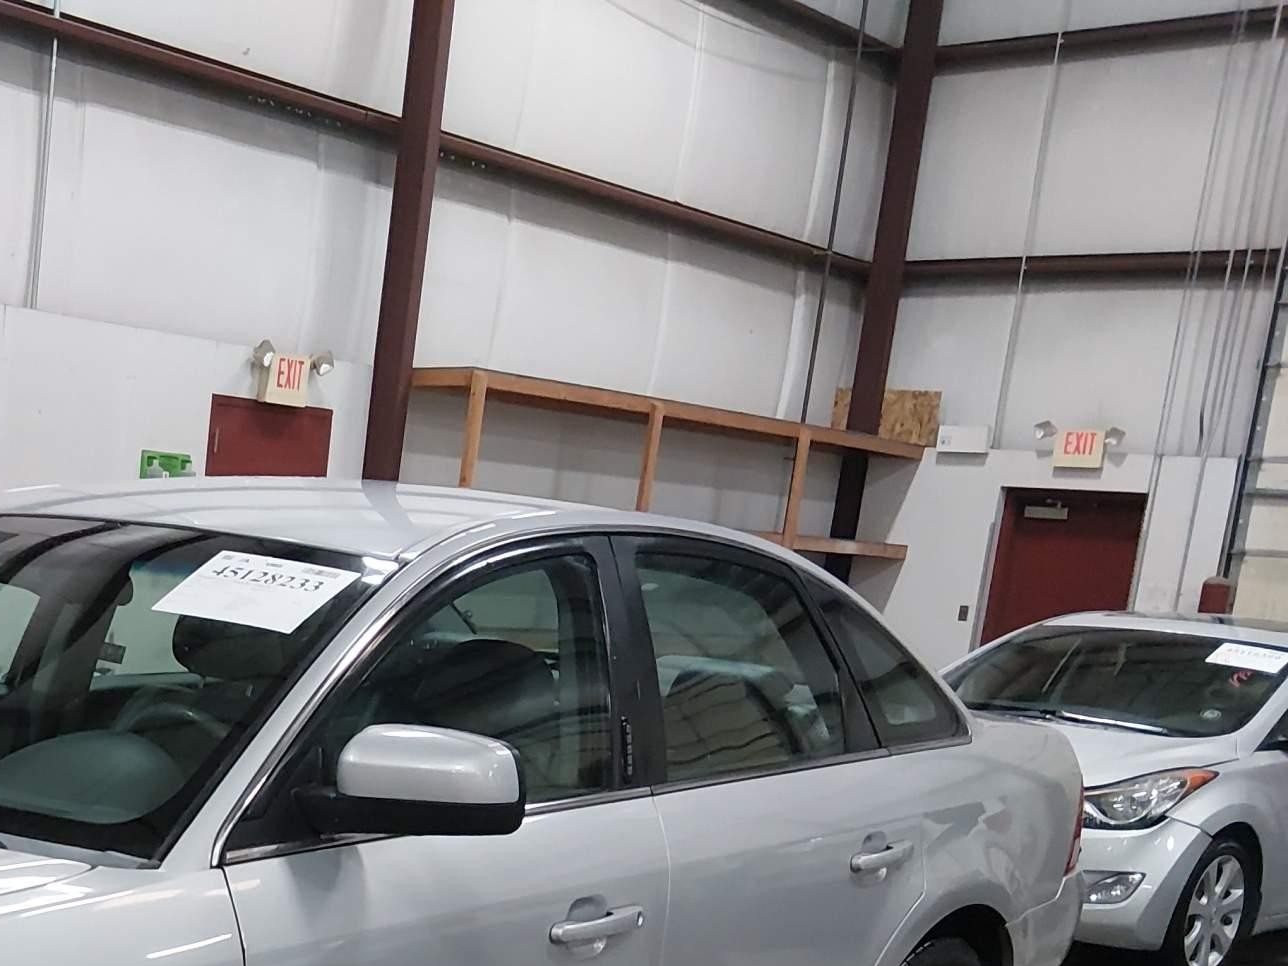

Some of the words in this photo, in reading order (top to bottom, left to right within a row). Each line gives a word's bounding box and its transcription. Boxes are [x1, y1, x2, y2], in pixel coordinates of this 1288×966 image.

[277, 357, 304, 391] EXIT
[1064, 431, 1096, 456] EXIT
[213, 565, 325, 592] 45128233
